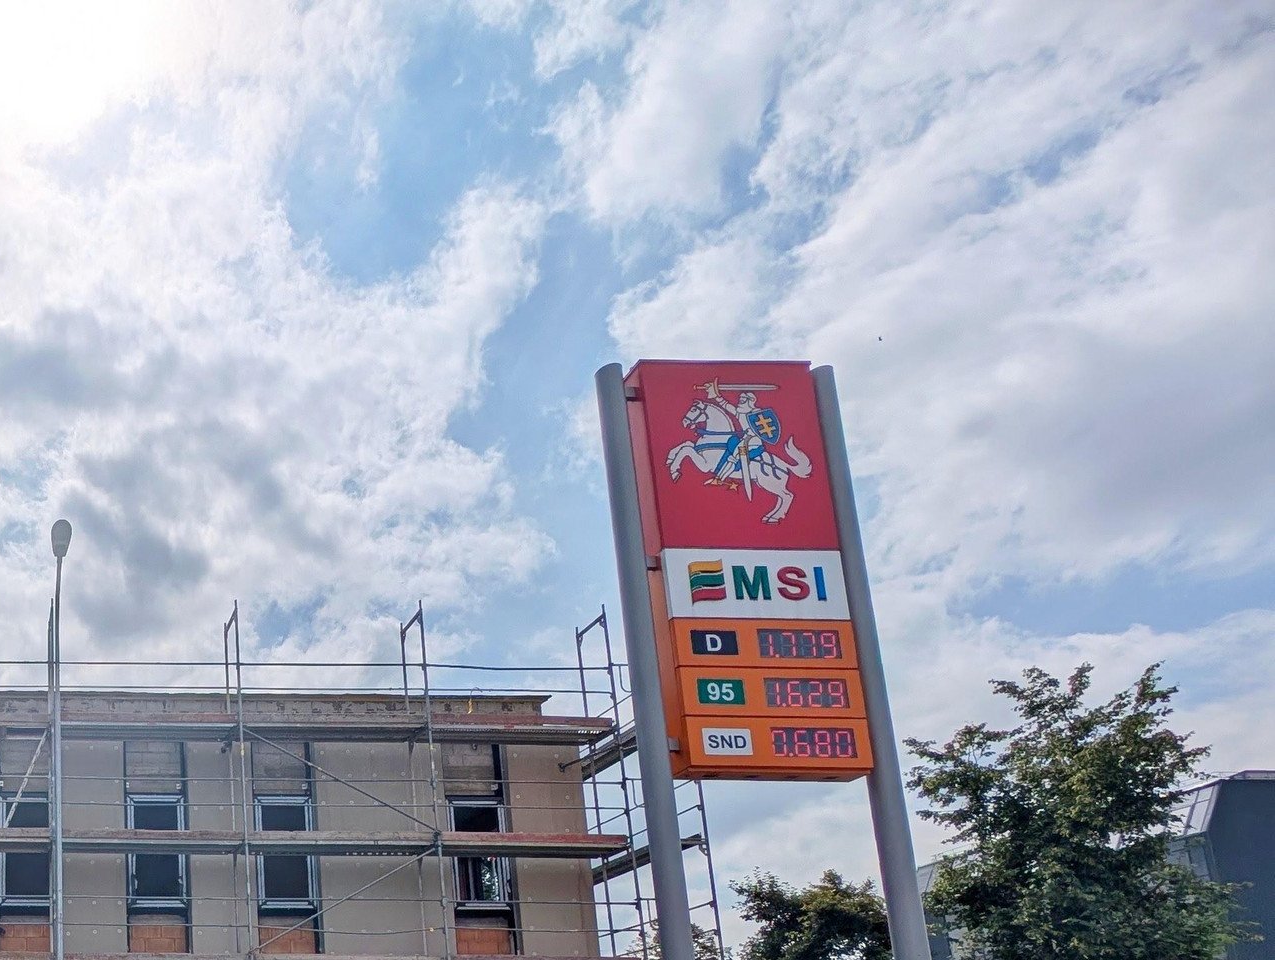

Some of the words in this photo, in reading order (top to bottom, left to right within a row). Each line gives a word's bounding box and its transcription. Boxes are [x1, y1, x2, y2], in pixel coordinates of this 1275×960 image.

[705, 634, 723, 652] D
[768, 632, 837, 660] 1.779
[706, 682, 735, 702] 95
[775, 681, 845, 708] 1.629
[708, 734, 747, 749] SND
[771, 730, 853, 758] 0.680
